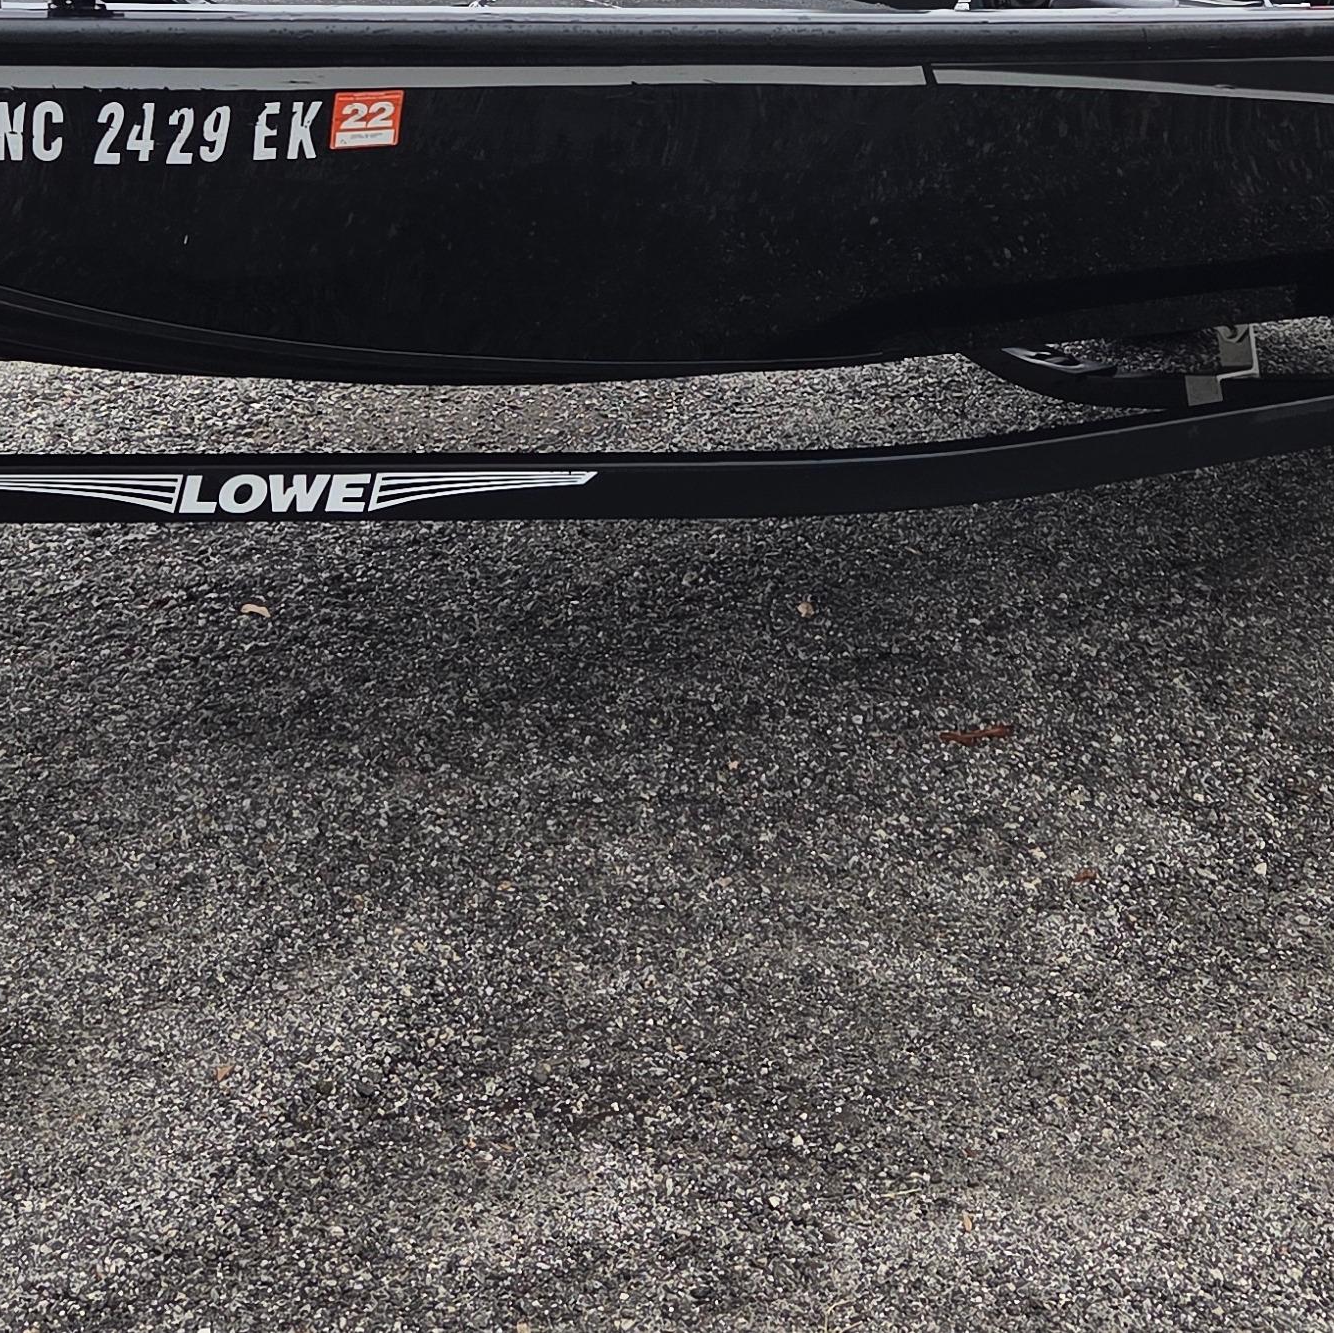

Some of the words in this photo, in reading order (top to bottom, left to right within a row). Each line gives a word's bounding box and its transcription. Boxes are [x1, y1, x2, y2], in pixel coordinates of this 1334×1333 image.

[93, 101, 231, 165] 2429
[252, 101, 323, 161] EK
[340, 101, 396, 130] 22
[178, 473, 372, 514] LOWE
